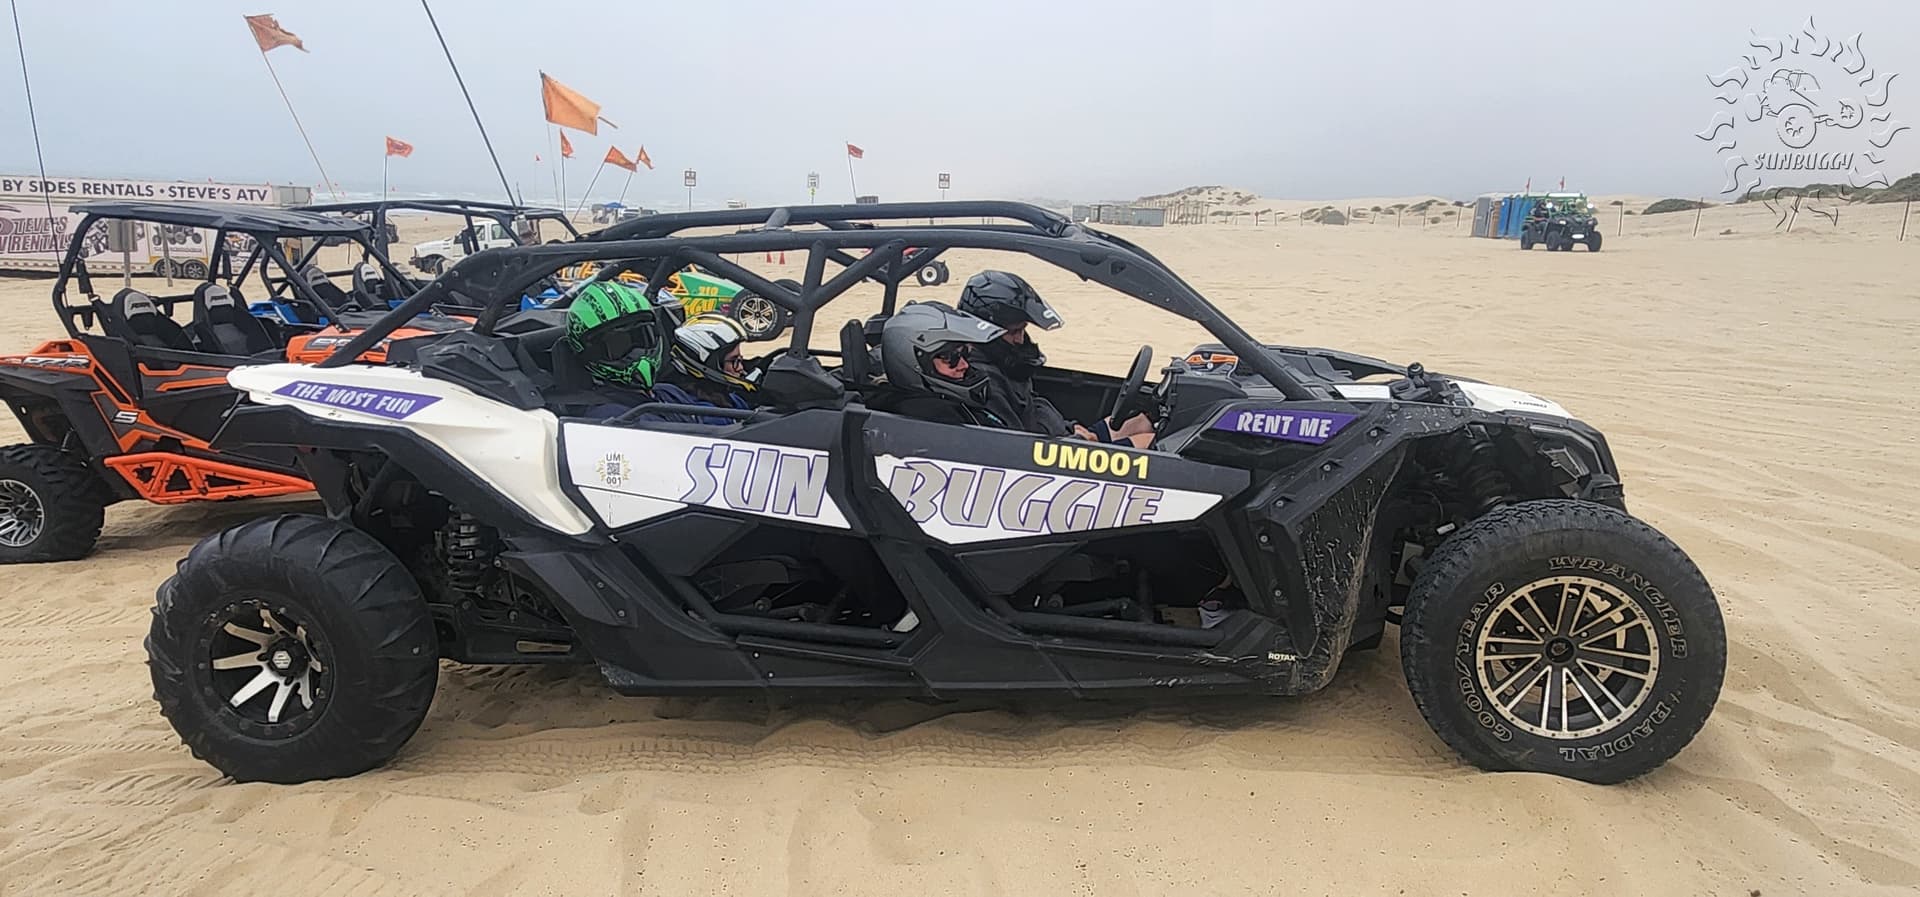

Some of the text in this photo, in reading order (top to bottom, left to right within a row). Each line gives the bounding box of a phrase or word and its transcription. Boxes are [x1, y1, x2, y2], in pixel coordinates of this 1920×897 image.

[3, 180, 268, 201] BY SIDES RENTALS STEVE'S ATV
[290, 383, 417, 415] THE MOST FUN
[1237, 411, 1332, 439] RENT ME
[606, 453, 621, 462] UM
[1033, 442, 1149, 480] UM001
[606, 477, 622, 487] 001
[680, 443, 1164, 533] SUN BUGGIE
[1549, 556, 1687, 658] WRANGLER
[1267, 652, 1297, 662] ROTAX
[1560, 701, 1672, 762] RADIAL
